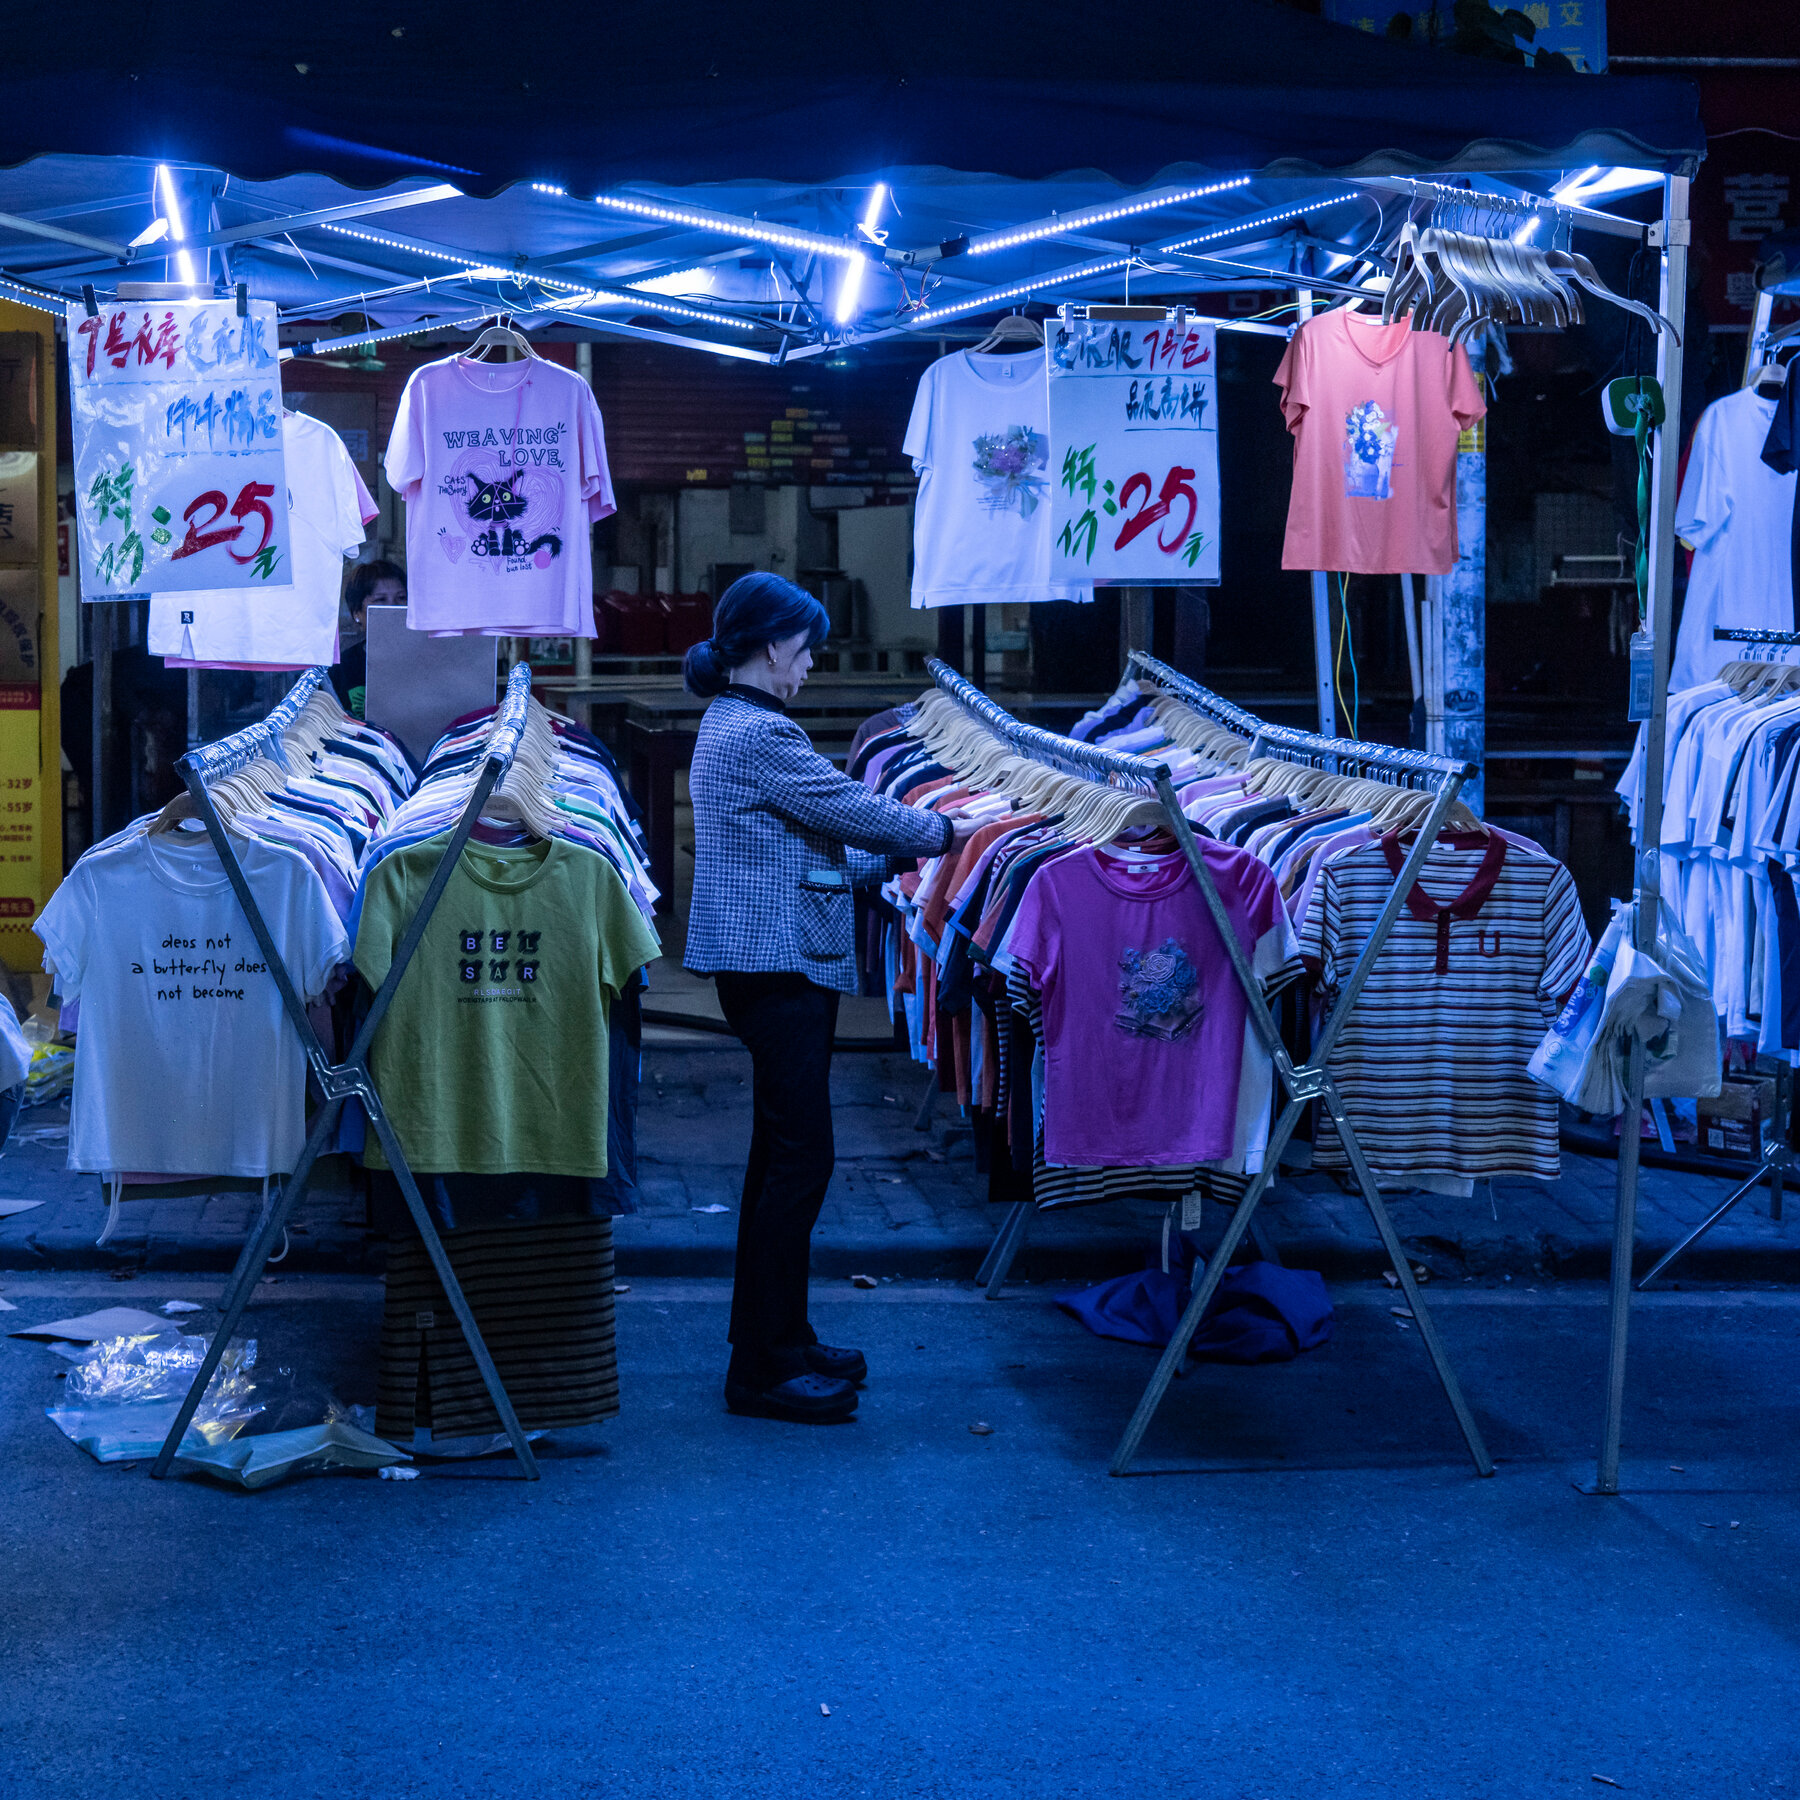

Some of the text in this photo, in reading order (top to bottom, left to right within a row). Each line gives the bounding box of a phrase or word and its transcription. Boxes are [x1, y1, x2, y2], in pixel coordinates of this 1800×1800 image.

[443, 428, 560, 448] WEAVING
[499, 449, 560, 466] LOVE
[206, 933, 231, 949] not
[1479, 930, 1501, 958] U
[131, 957, 268, 985] a butterfly does
[157, 985, 244, 1000] not become
